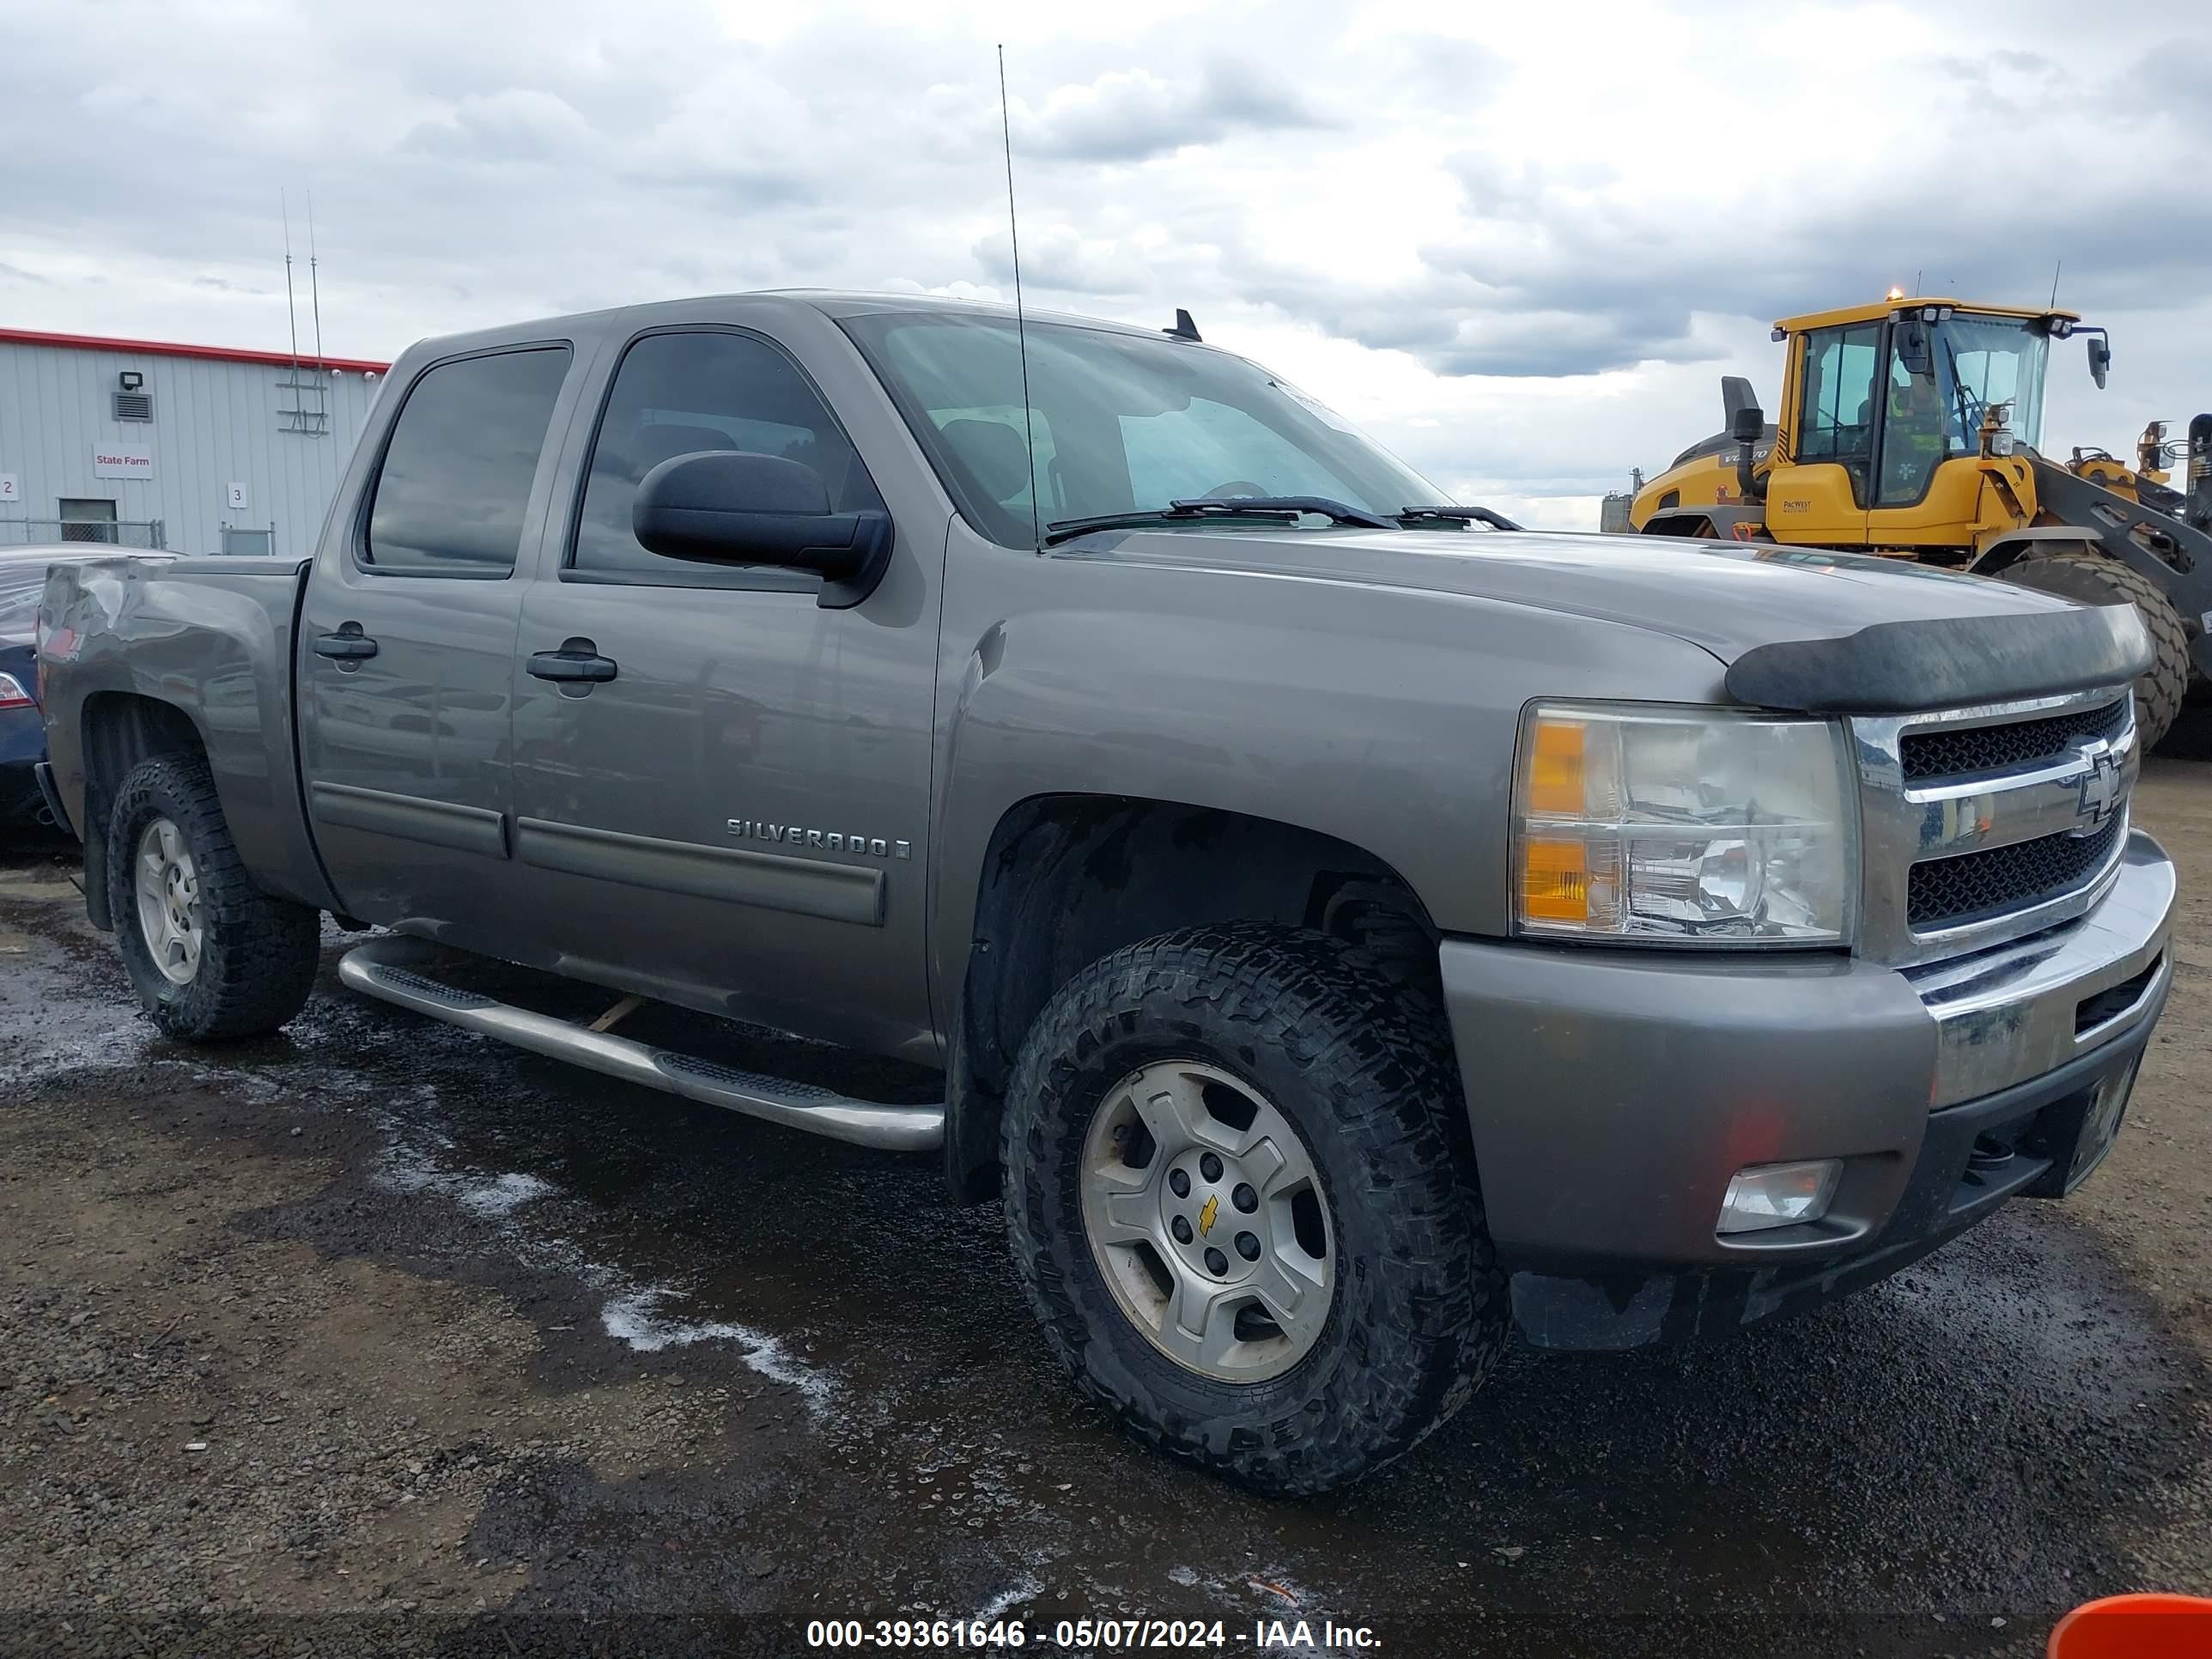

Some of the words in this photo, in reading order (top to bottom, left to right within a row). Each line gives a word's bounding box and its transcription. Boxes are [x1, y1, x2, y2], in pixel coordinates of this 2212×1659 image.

[96, 455, 123, 465] State
[125, 456, 149, 465] Farm
[1725, 450, 1768, 463] VOVO
[3, 481, 13, 493] 2
[234, 489, 241, 501] 3
[727, 818, 887, 857] SILVERADO
